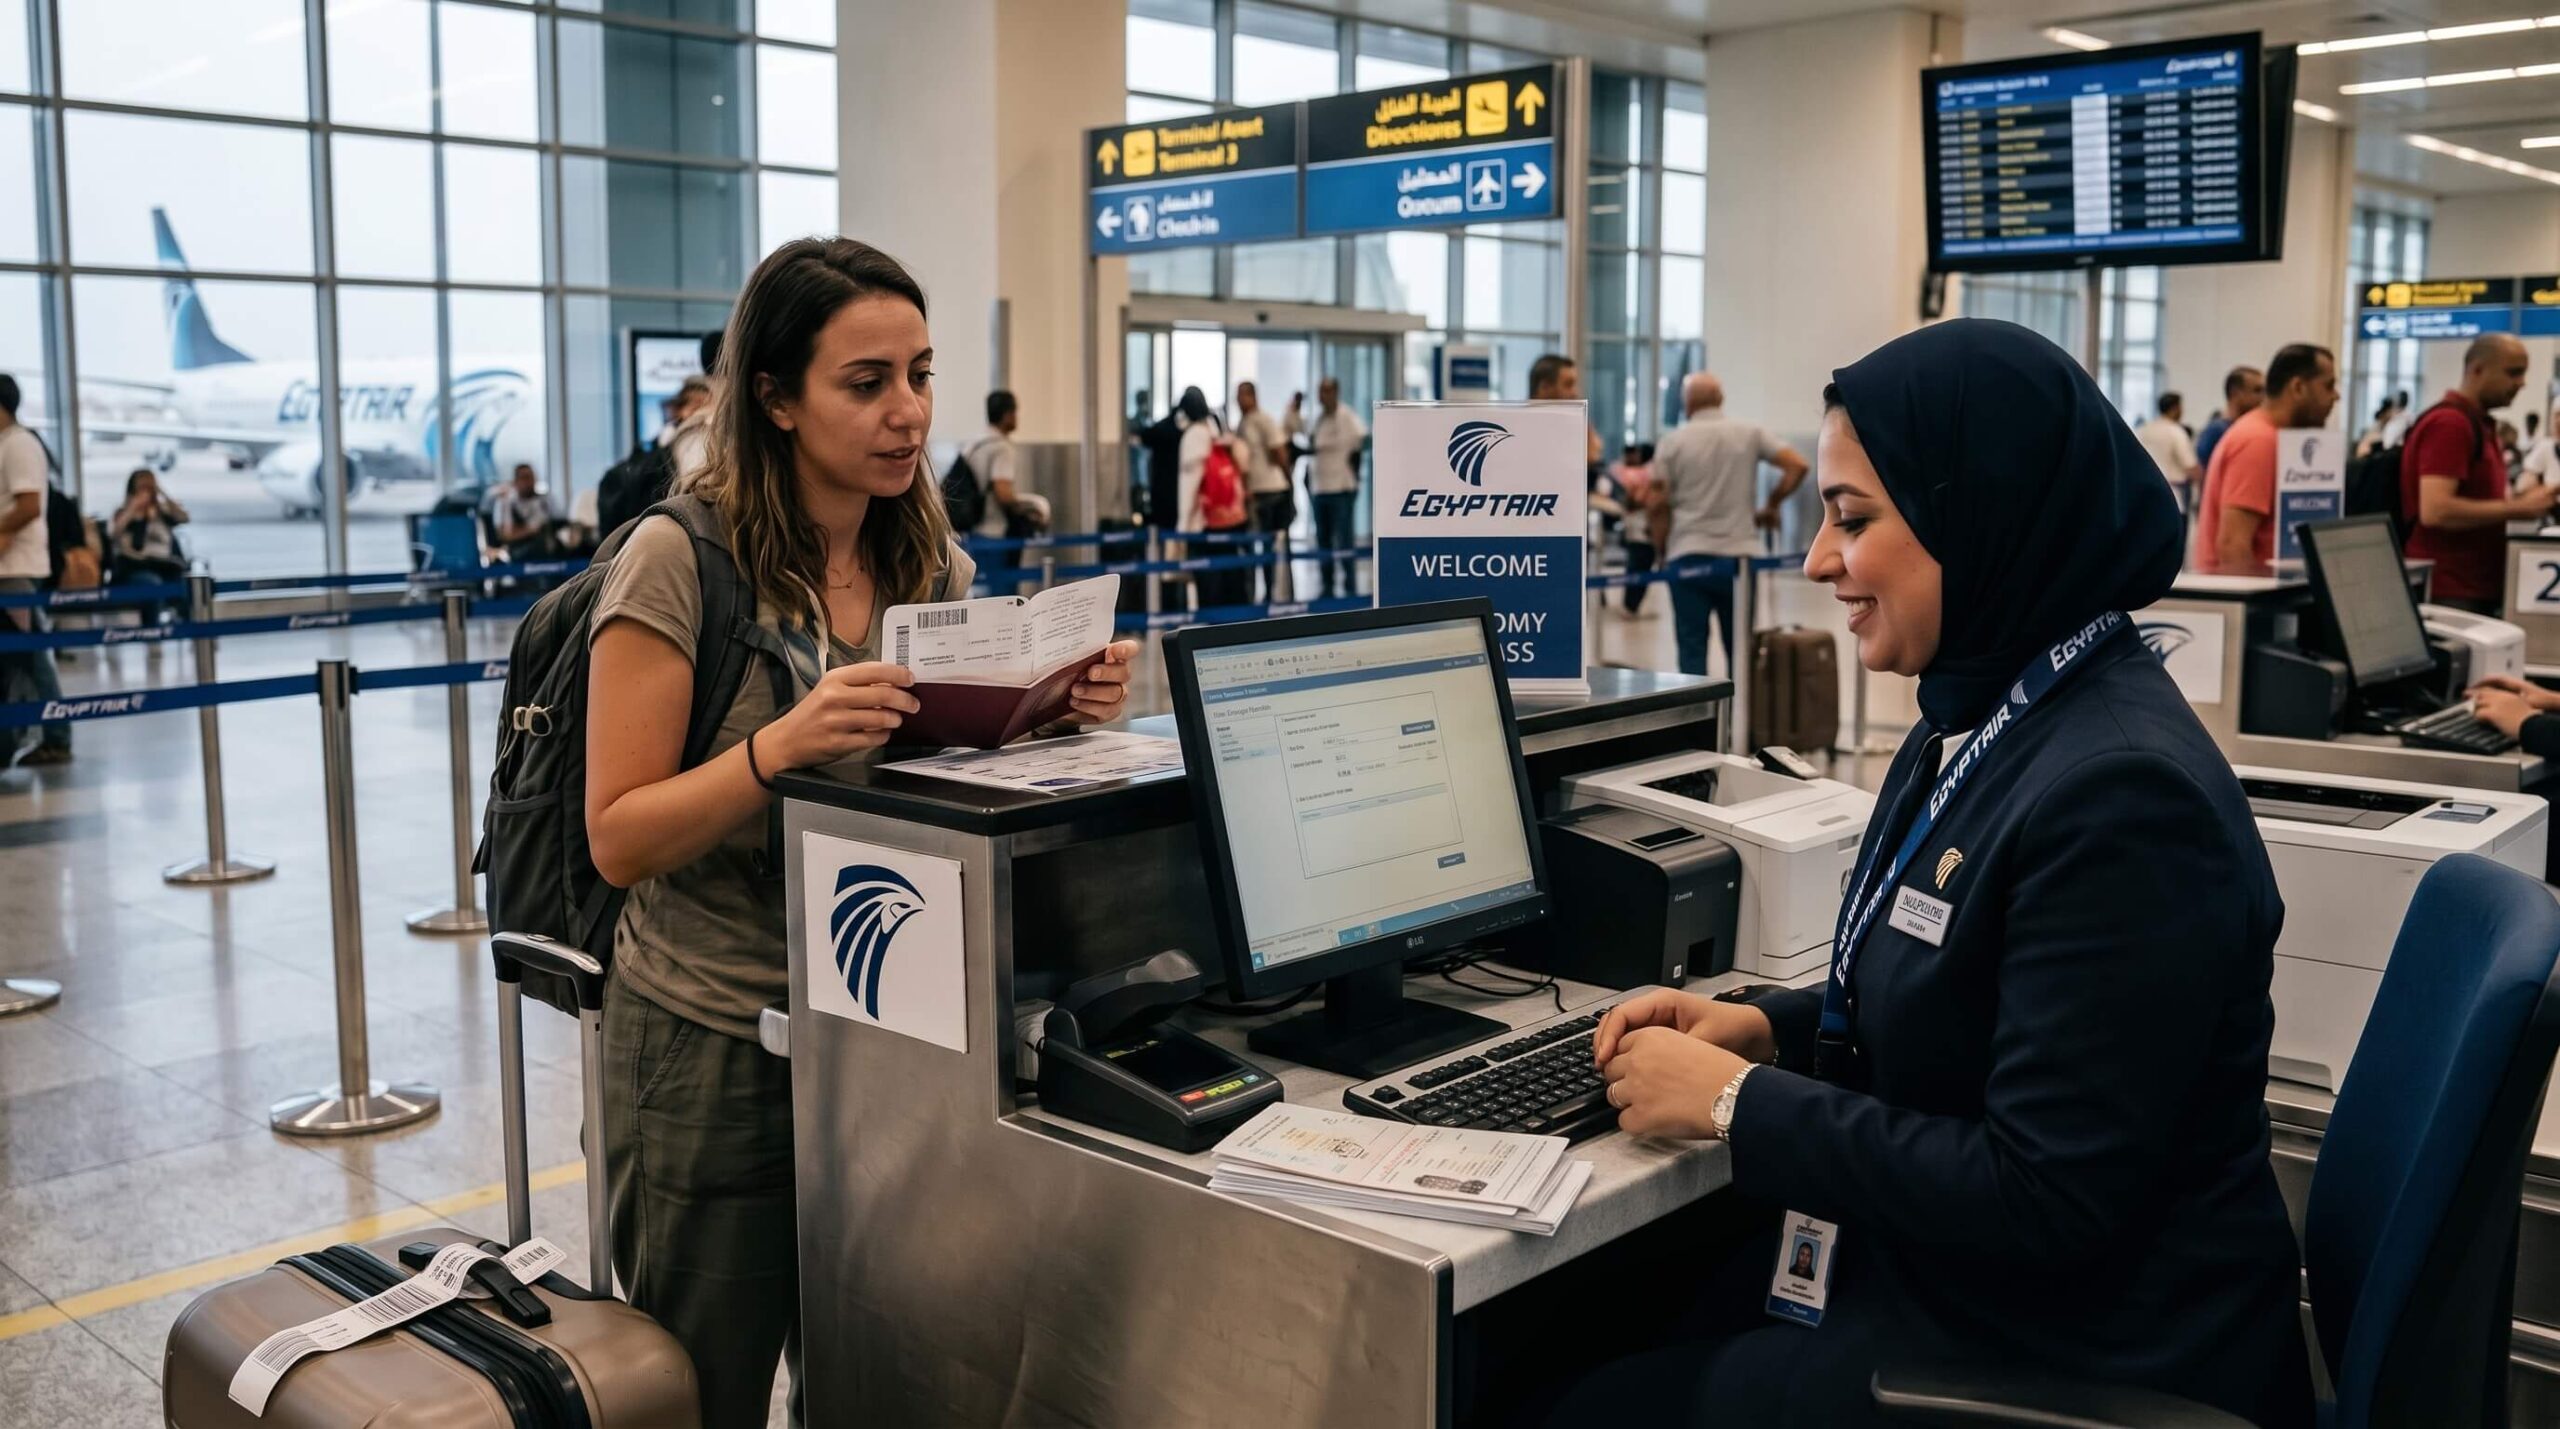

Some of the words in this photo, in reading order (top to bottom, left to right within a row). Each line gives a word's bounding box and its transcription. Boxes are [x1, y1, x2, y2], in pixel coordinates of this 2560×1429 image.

[1400, 488, 1560, 517] EGYPTAIR
[1411, 554, 1548, 578] WELCOME
[42, 696, 129, 720] EGYPTAIR
[1930, 703, 2012, 822] EGYPTAIR
